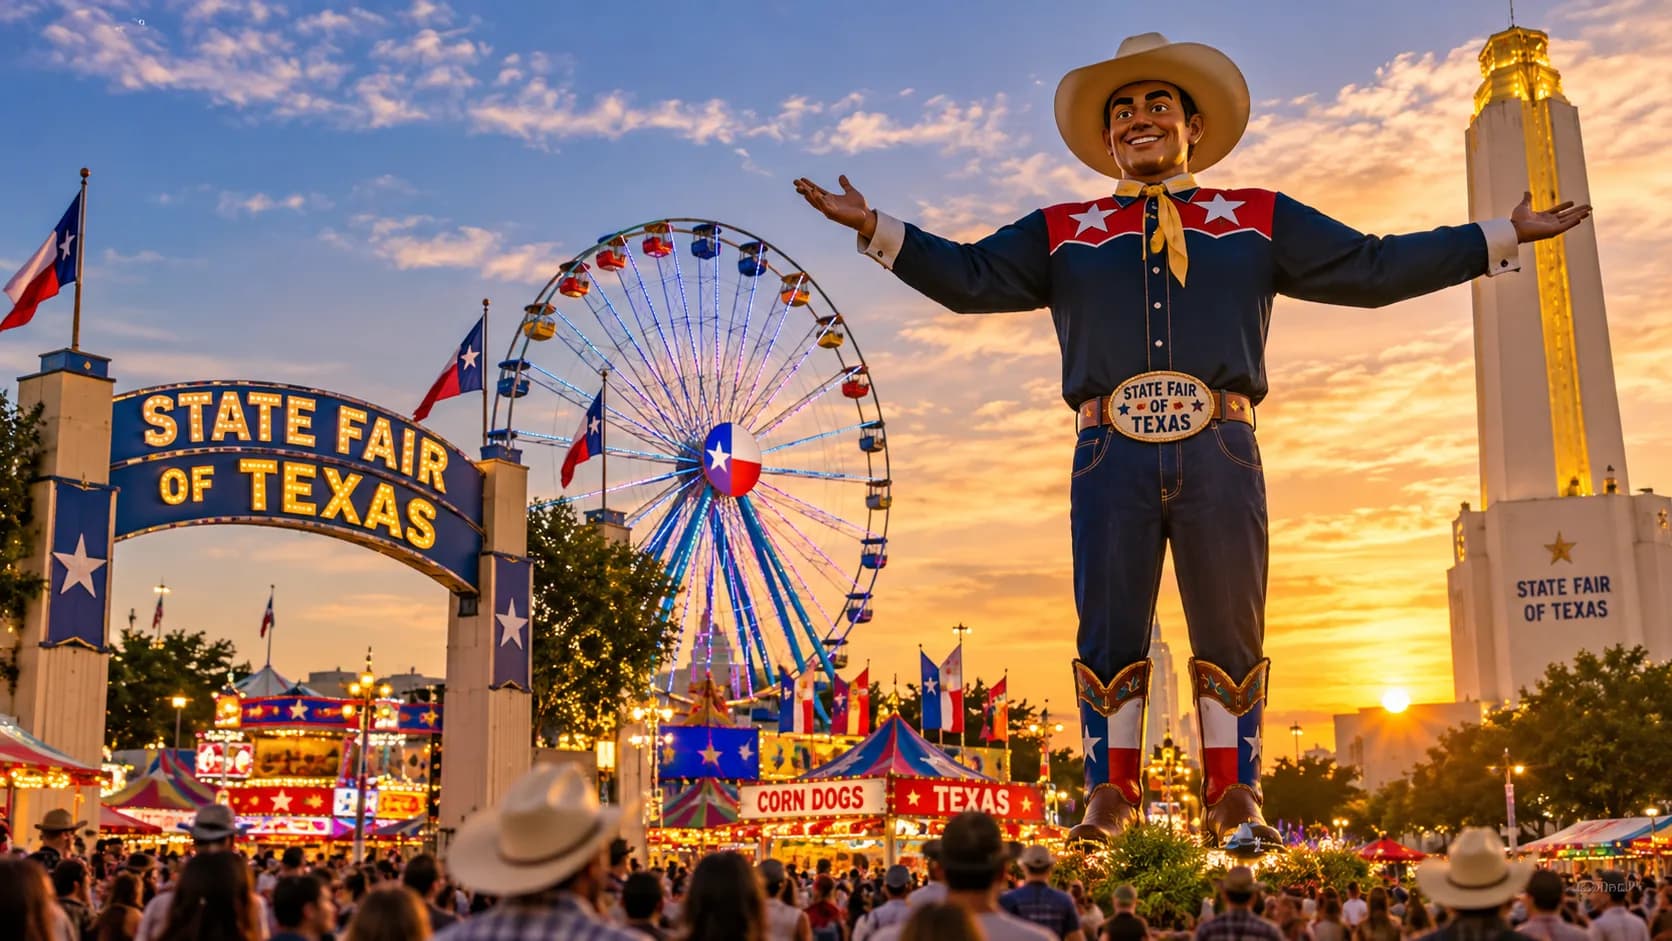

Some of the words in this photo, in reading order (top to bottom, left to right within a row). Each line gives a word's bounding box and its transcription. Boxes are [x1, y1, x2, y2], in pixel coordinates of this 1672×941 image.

[1123, 381, 1162, 400] STATE
[1167, 381, 1197, 397] FAIR
[1150, 399, 1168, 413] OF
[1131, 414, 1191, 433] TEXAS
[142, 390, 317, 448] STATE
[336, 405, 449, 494] FAIR
[159, 465, 215, 506] OF
[239, 458, 437, 550] TEXAS
[1517, 578, 1567, 598] STATE
[1573, 575, 1611, 594] FAIR
[1524, 603, 1545, 622] OF
[1551, 600, 1608, 620] TEXAS
[757, 789, 805, 813] CORN
[812, 785, 864, 811] DOGS
[933, 785, 1010, 815] TEXAS
